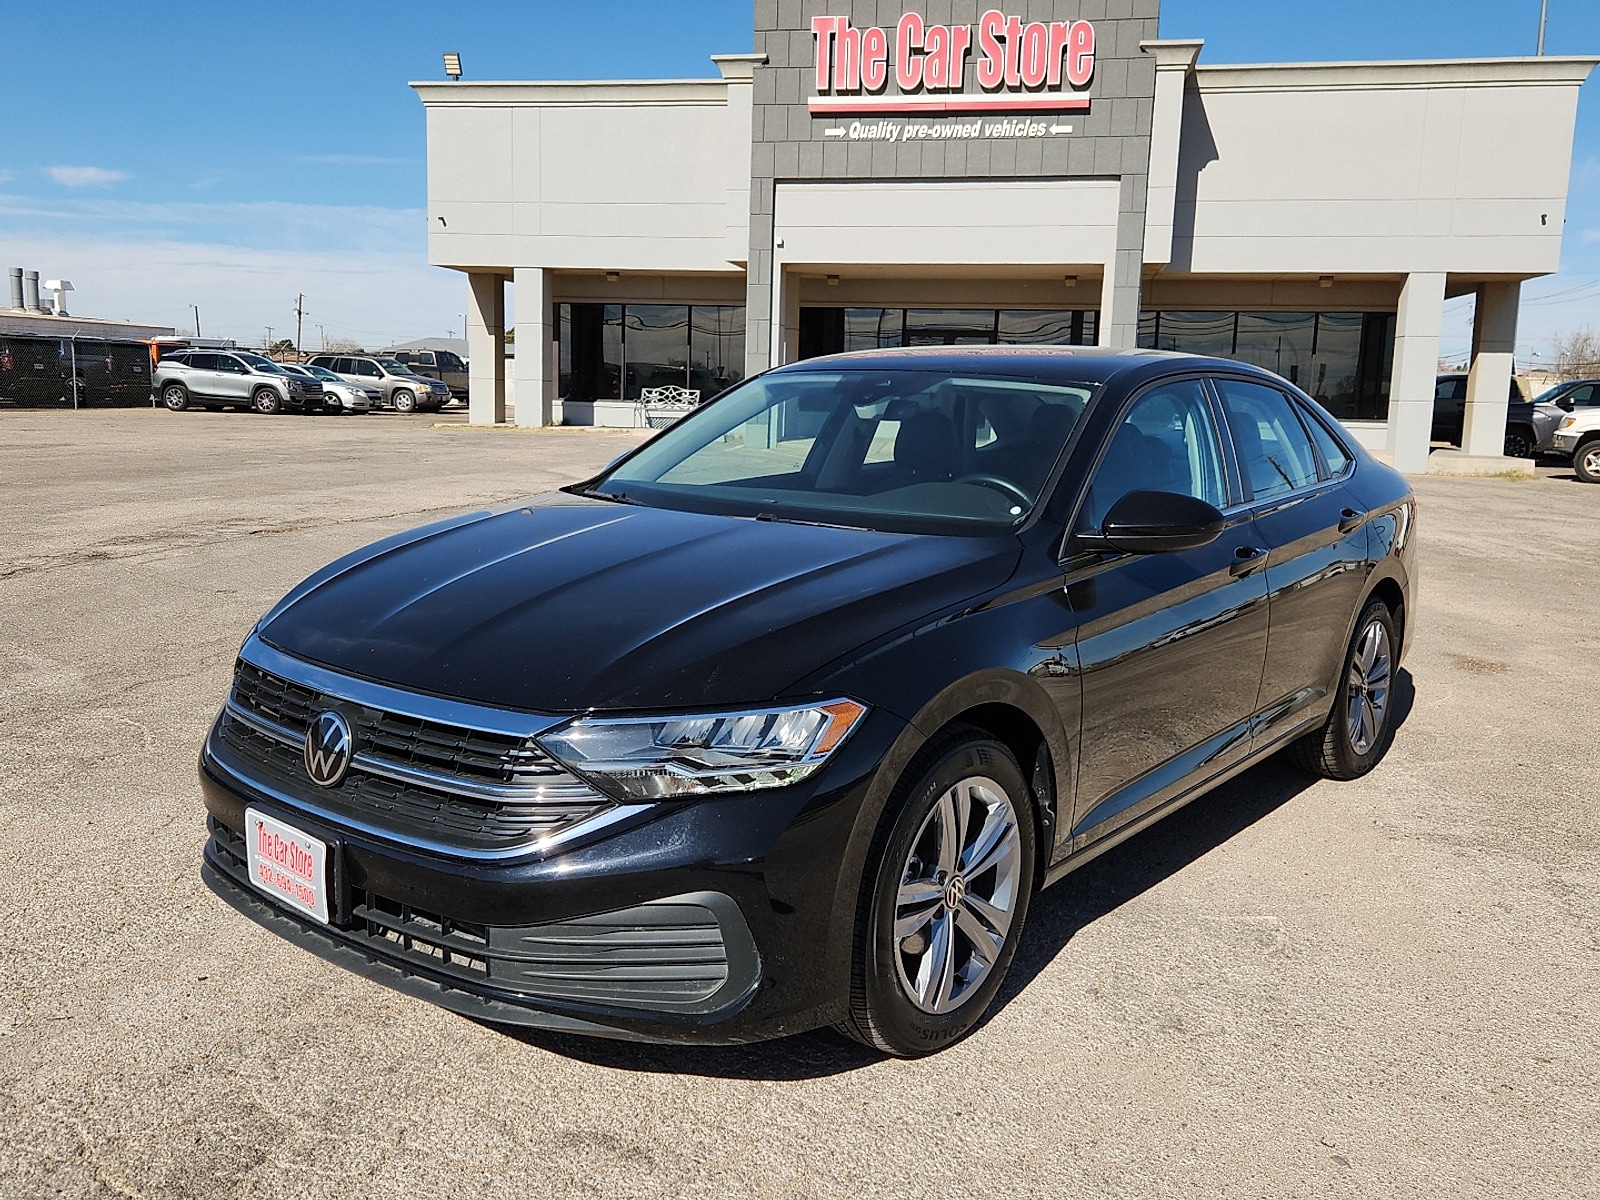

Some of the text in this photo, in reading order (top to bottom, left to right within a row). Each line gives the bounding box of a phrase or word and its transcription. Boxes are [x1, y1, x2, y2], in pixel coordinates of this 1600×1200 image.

[811, 9, 1095, 91] The Car Store
[849, 119, 1047, 142] Quality pre-owned vehicles
[257, 822, 273, 858] The
[274, 832, 288, 866] Car
[289, 840, 314, 880] Store
